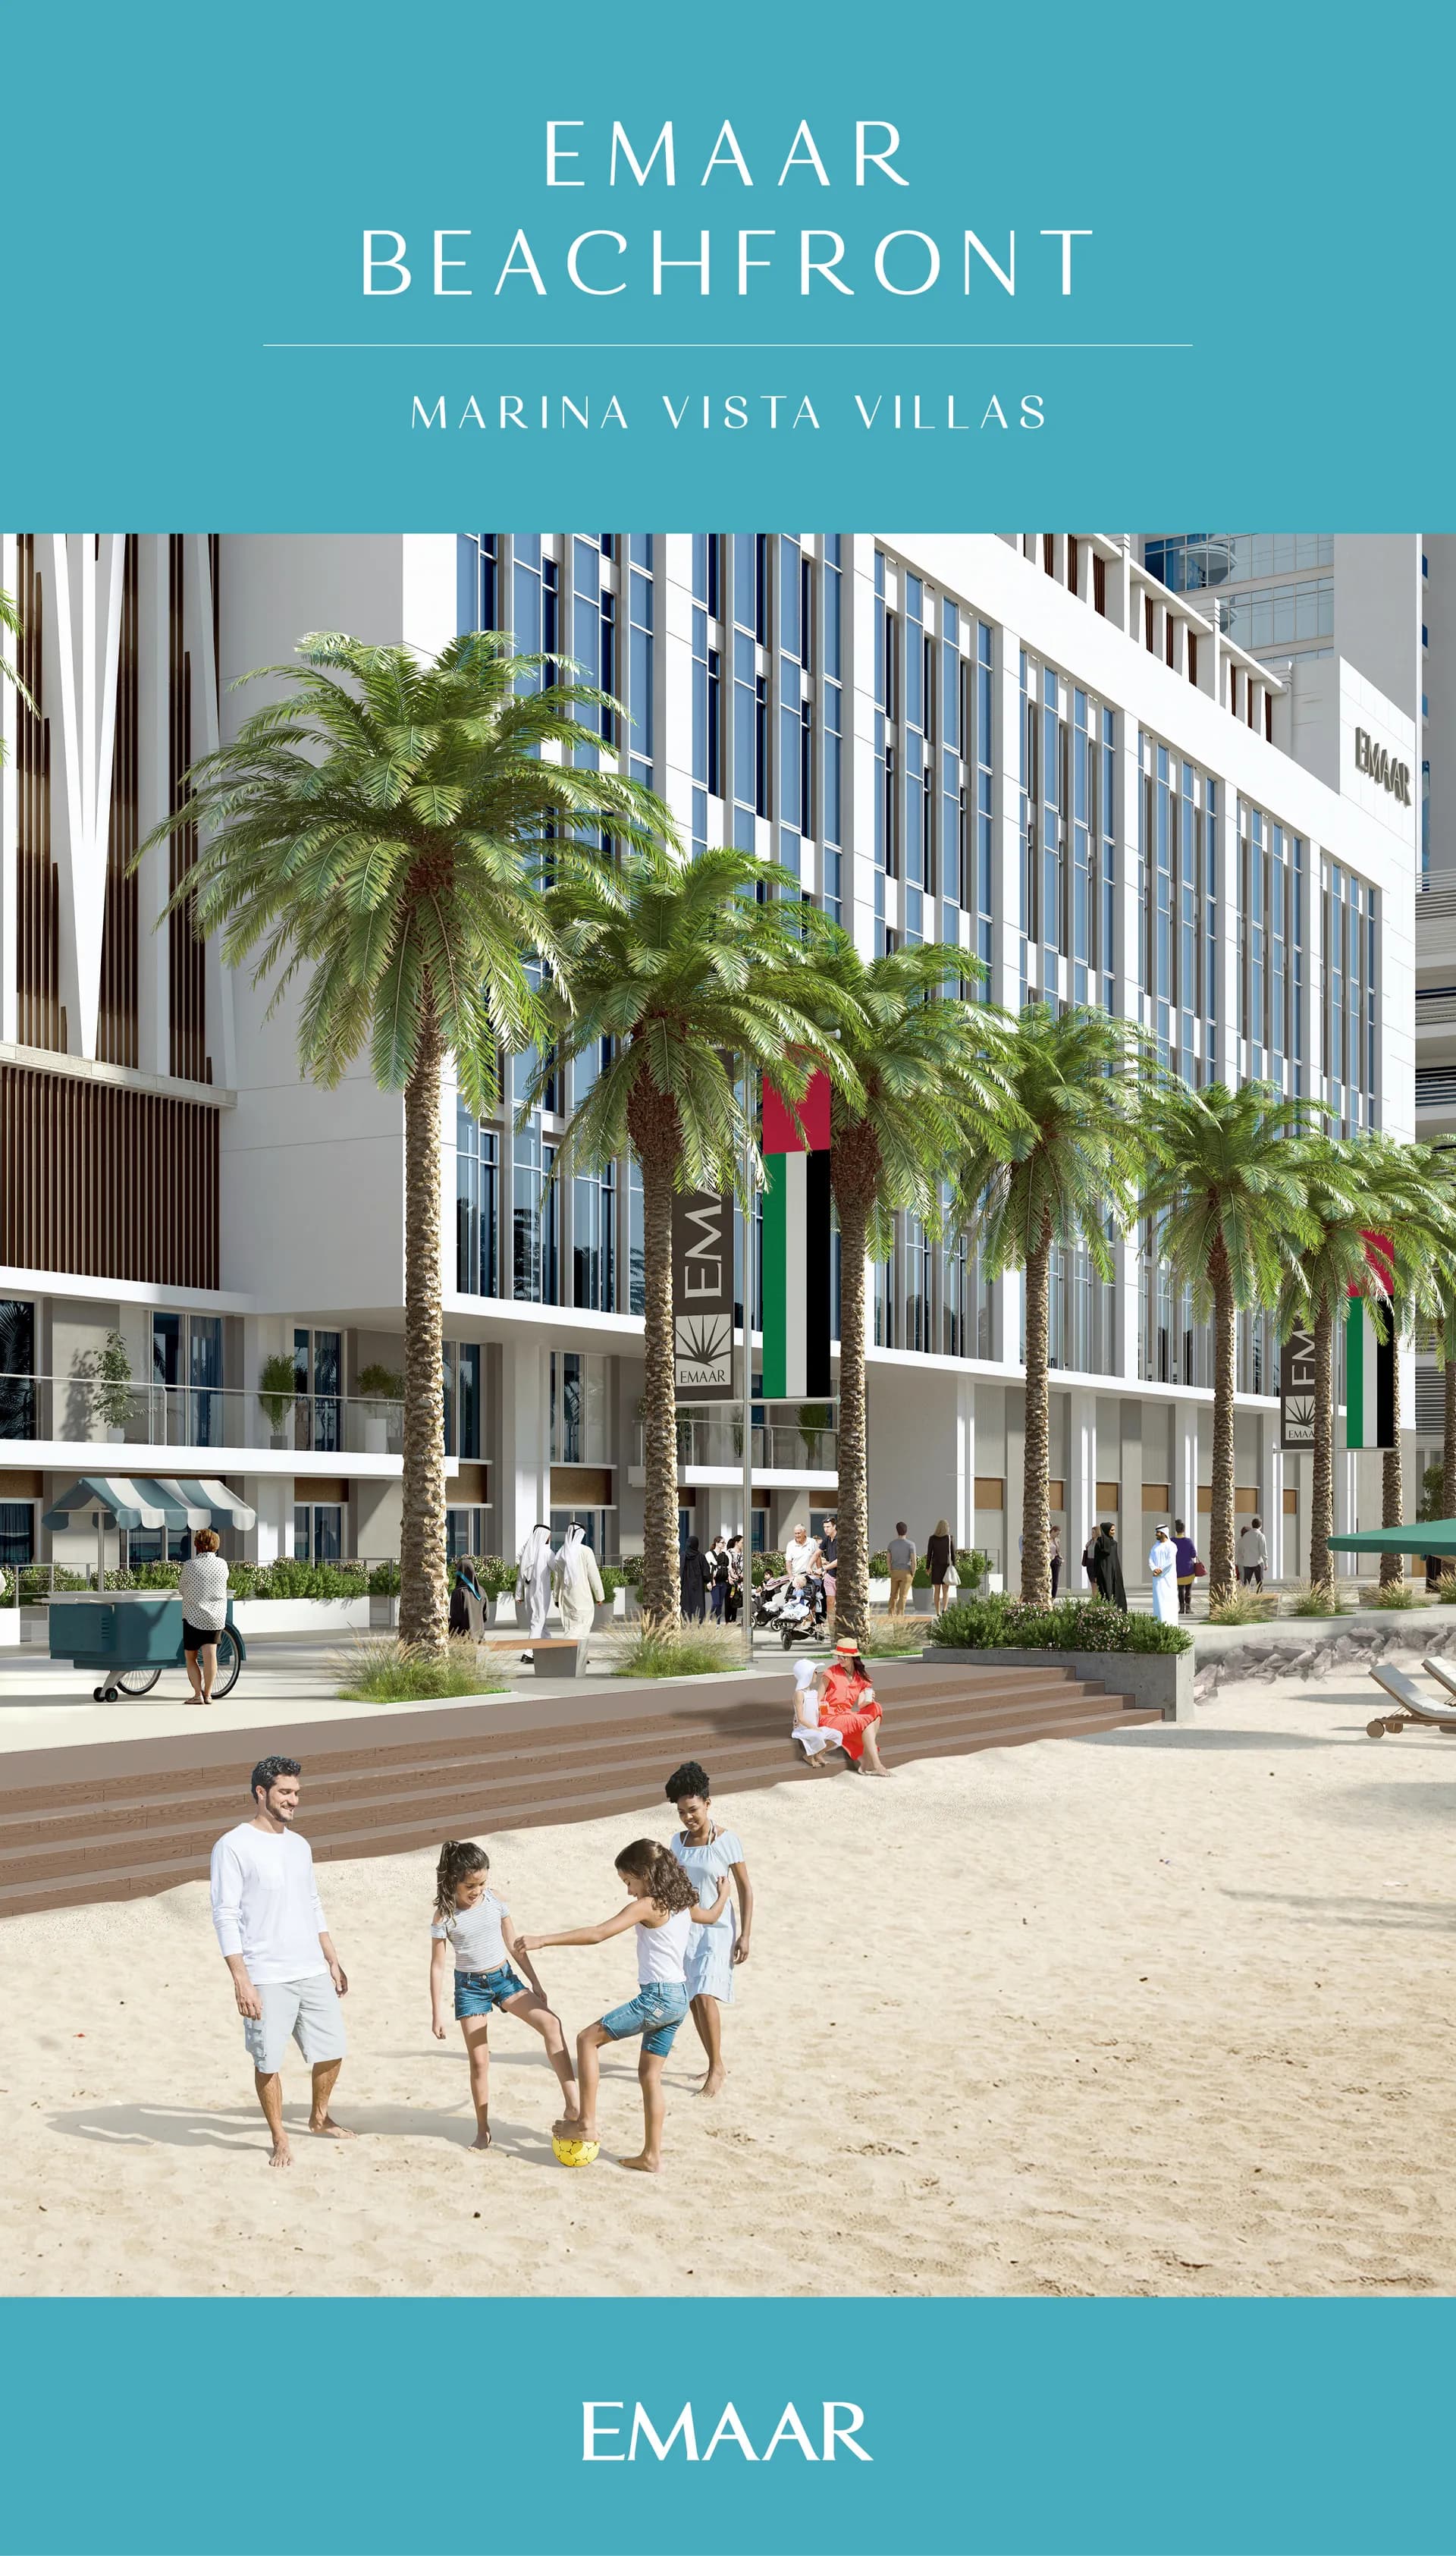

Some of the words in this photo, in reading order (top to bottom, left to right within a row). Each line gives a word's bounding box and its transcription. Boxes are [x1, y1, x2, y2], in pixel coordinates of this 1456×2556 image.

[1354, 727, 1412, 808] EMAAR
[684, 1187, 722, 1299] EM
[680, 1369, 726, 1383] EMAAR
[1291, 1320, 1316, 1386] EM
[1288, 1430, 1316, 1439] EMAA
